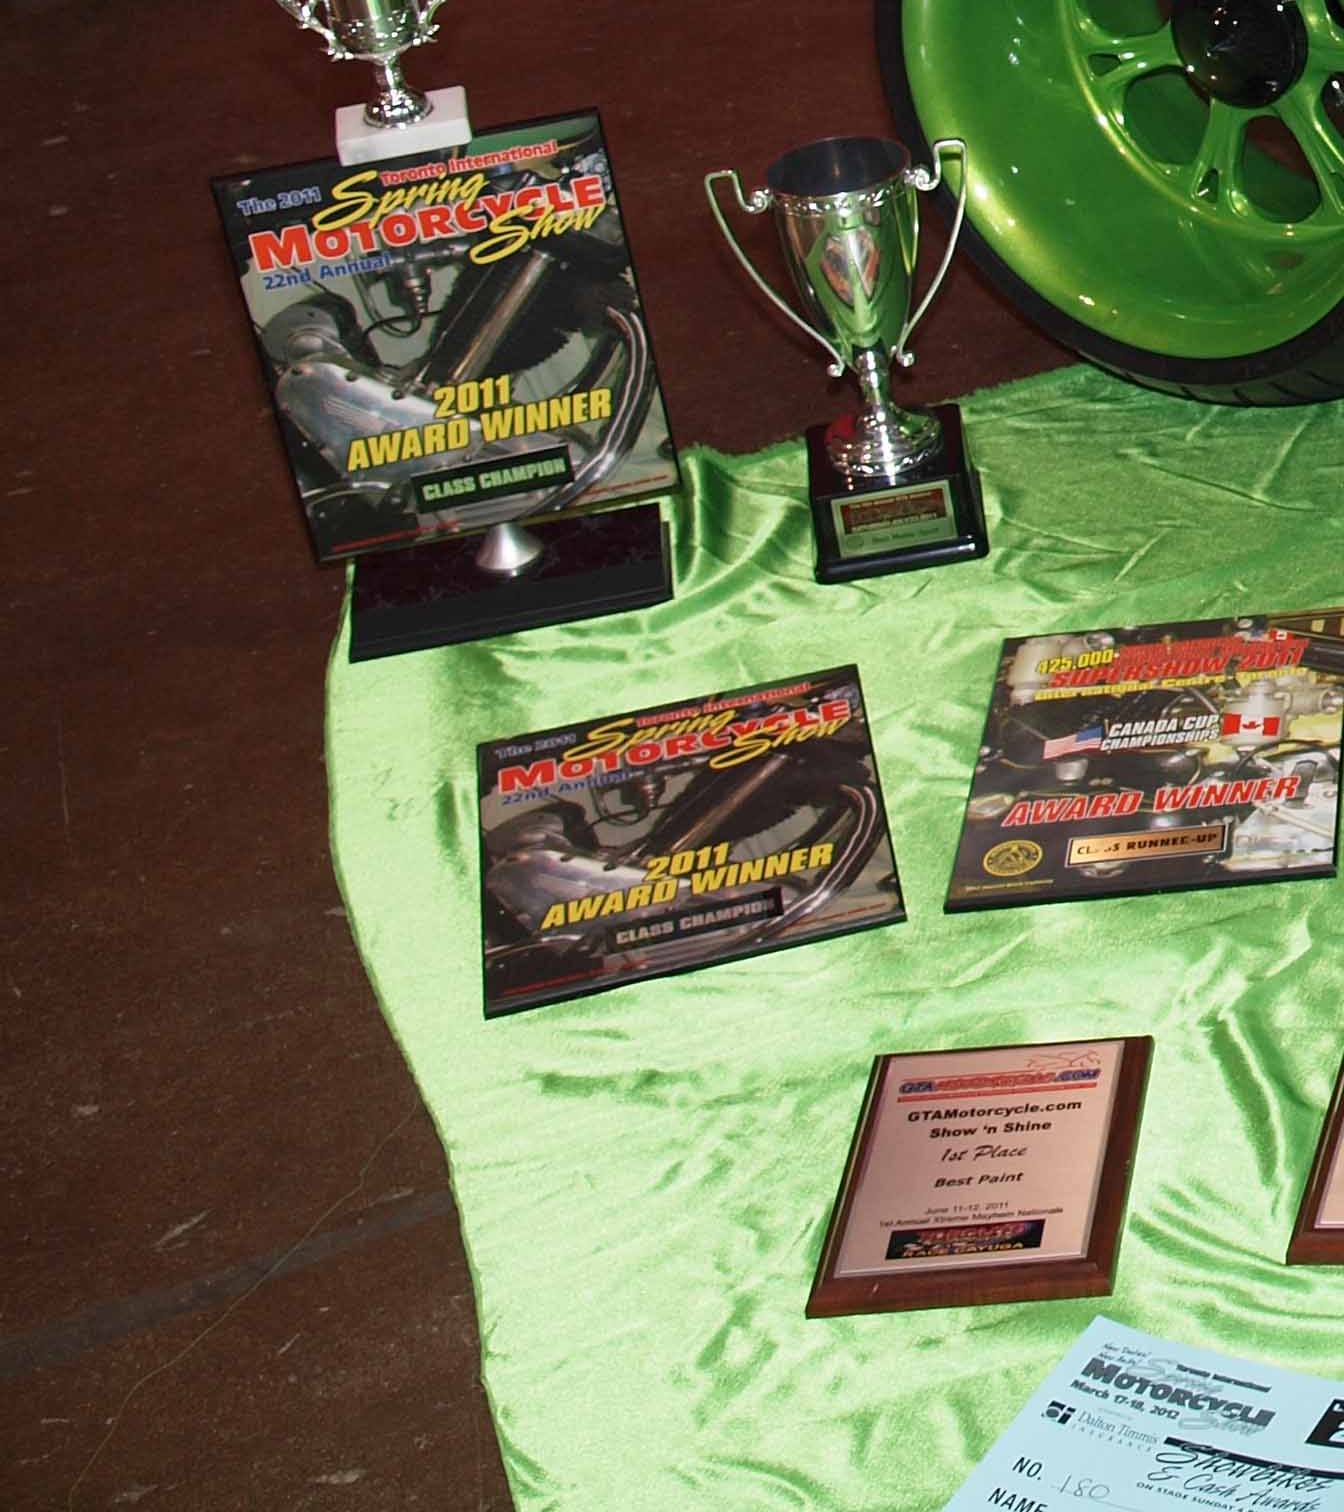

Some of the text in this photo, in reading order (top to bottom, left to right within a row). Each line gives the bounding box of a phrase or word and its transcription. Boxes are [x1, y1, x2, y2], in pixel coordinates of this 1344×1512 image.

[379, 139, 560, 187] Toronto International
[236, 170, 490, 232] The 2011 Spring
[249, 175, 607, 272] MOTORCYCLE
[469, 202, 607, 265] Show
[262, 251, 393, 291] 22nd Annual
[433, 374, 512, 419] 2011
[347, 387, 613, 473] AWARD WINNER
[421, 475, 476, 502] CLASS
[480, 458, 567, 489] CHAMPION
[498, 698, 851, 793] MOTORCYCLE
[563, 710, 738, 761] Spring
[709, 718, 848, 770] Show
[1101, 727, 1221, 751] CHAMPIONSHIPS
[1108, 714, 1220, 738] CANADA CUP
[1001, 776, 1301, 827] AWARD WINNER
[643, 841, 731, 881] 2011
[540, 841, 836, 932] AWARD WINNER
[615, 920, 674, 946] CLASS
[679, 897, 775, 931] CHAMPION
[908, 1100, 1082, 1122] GTAMotorcycle.com
[929, 1125, 979, 1139] Show
[1003, 1119, 1052, 1133] Shine
[973, 1144, 1029, 1161] Place
[934, 1171, 1025, 1188] Best Paint
[1070, 1378, 1110, 1400] March
[1149, 1404, 1181, 1420] 2012
[1076, 1410, 1116, 1435] Dalton
[1012, 1456, 1043, 1481] NO.
[1058, 1474, 1111, 1499] 180
[1136, 1481, 1235, 1510] ON STAGE SUNDAY
[1184, 1473, 1241, 1499] Cash
[1236, 1488, 1321, 1512] Awards
